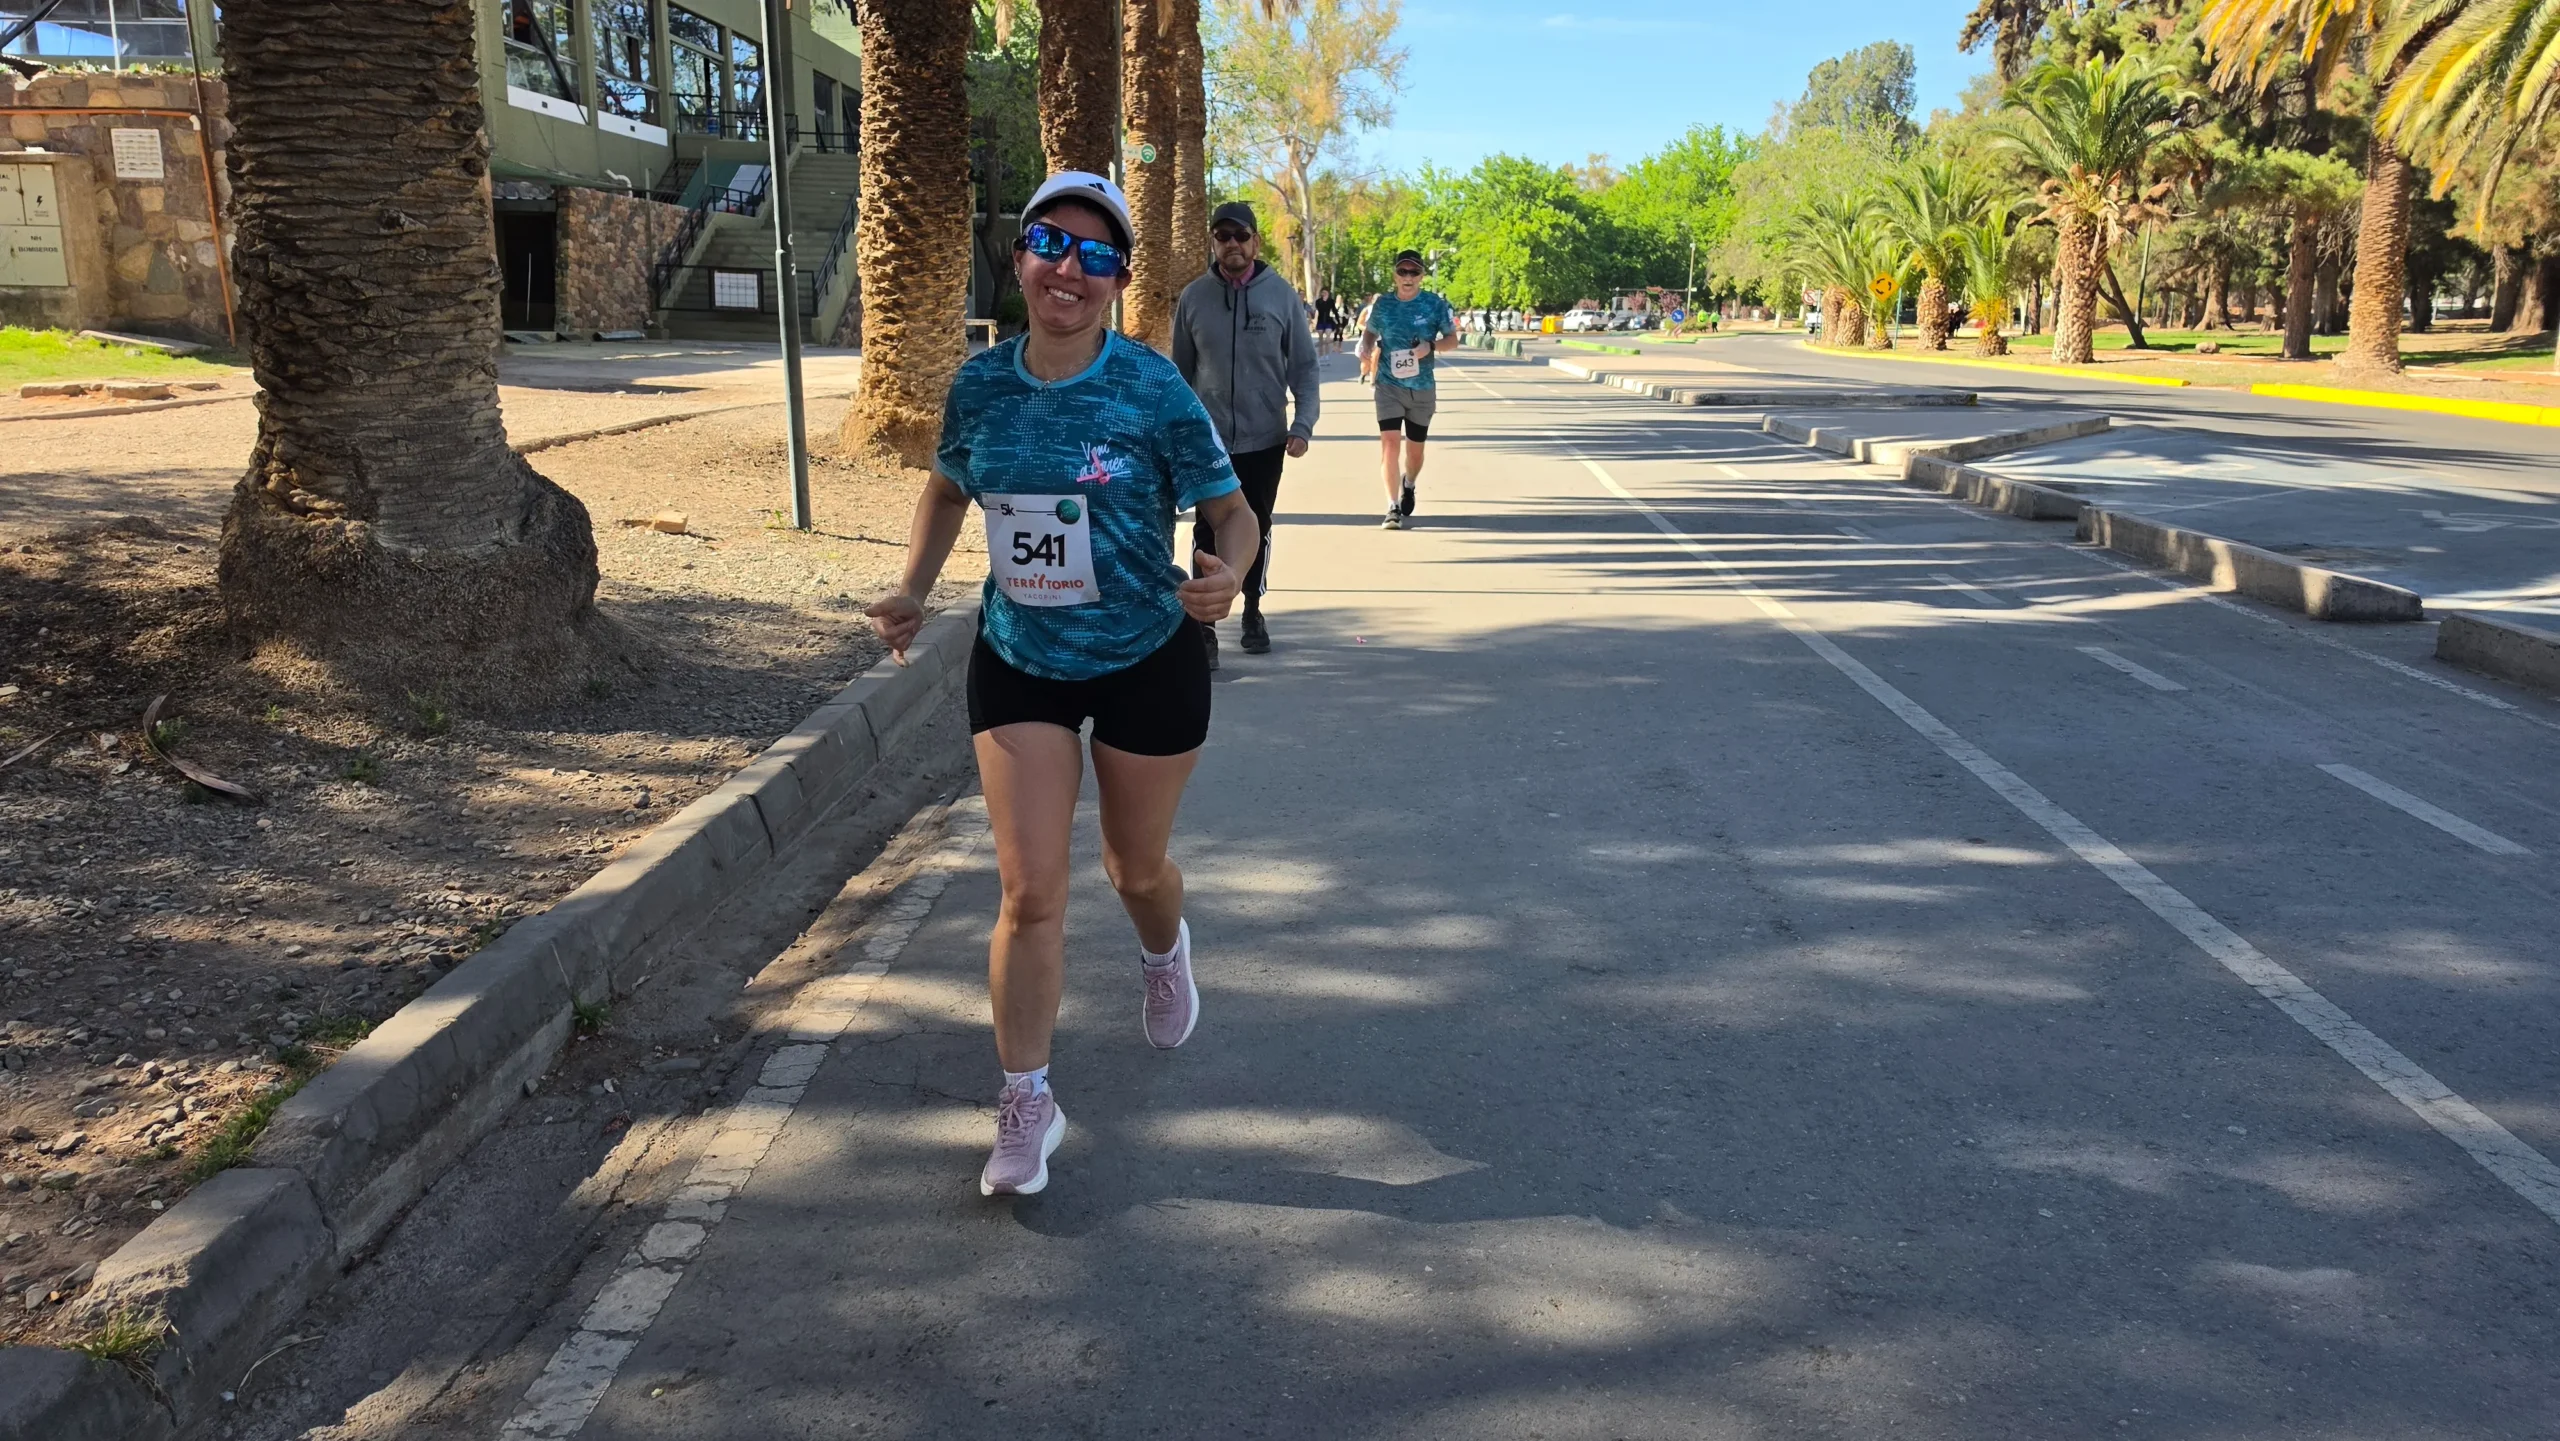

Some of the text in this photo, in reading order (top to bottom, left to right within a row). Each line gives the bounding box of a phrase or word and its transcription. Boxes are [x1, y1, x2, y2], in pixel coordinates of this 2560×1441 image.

[1395, 358, 1414, 369] 643
[1000, 503, 1016, 517] 5k
[1011, 531, 1066, 568] 541
[1005, 573, 1085, 590] TERRITORIO
